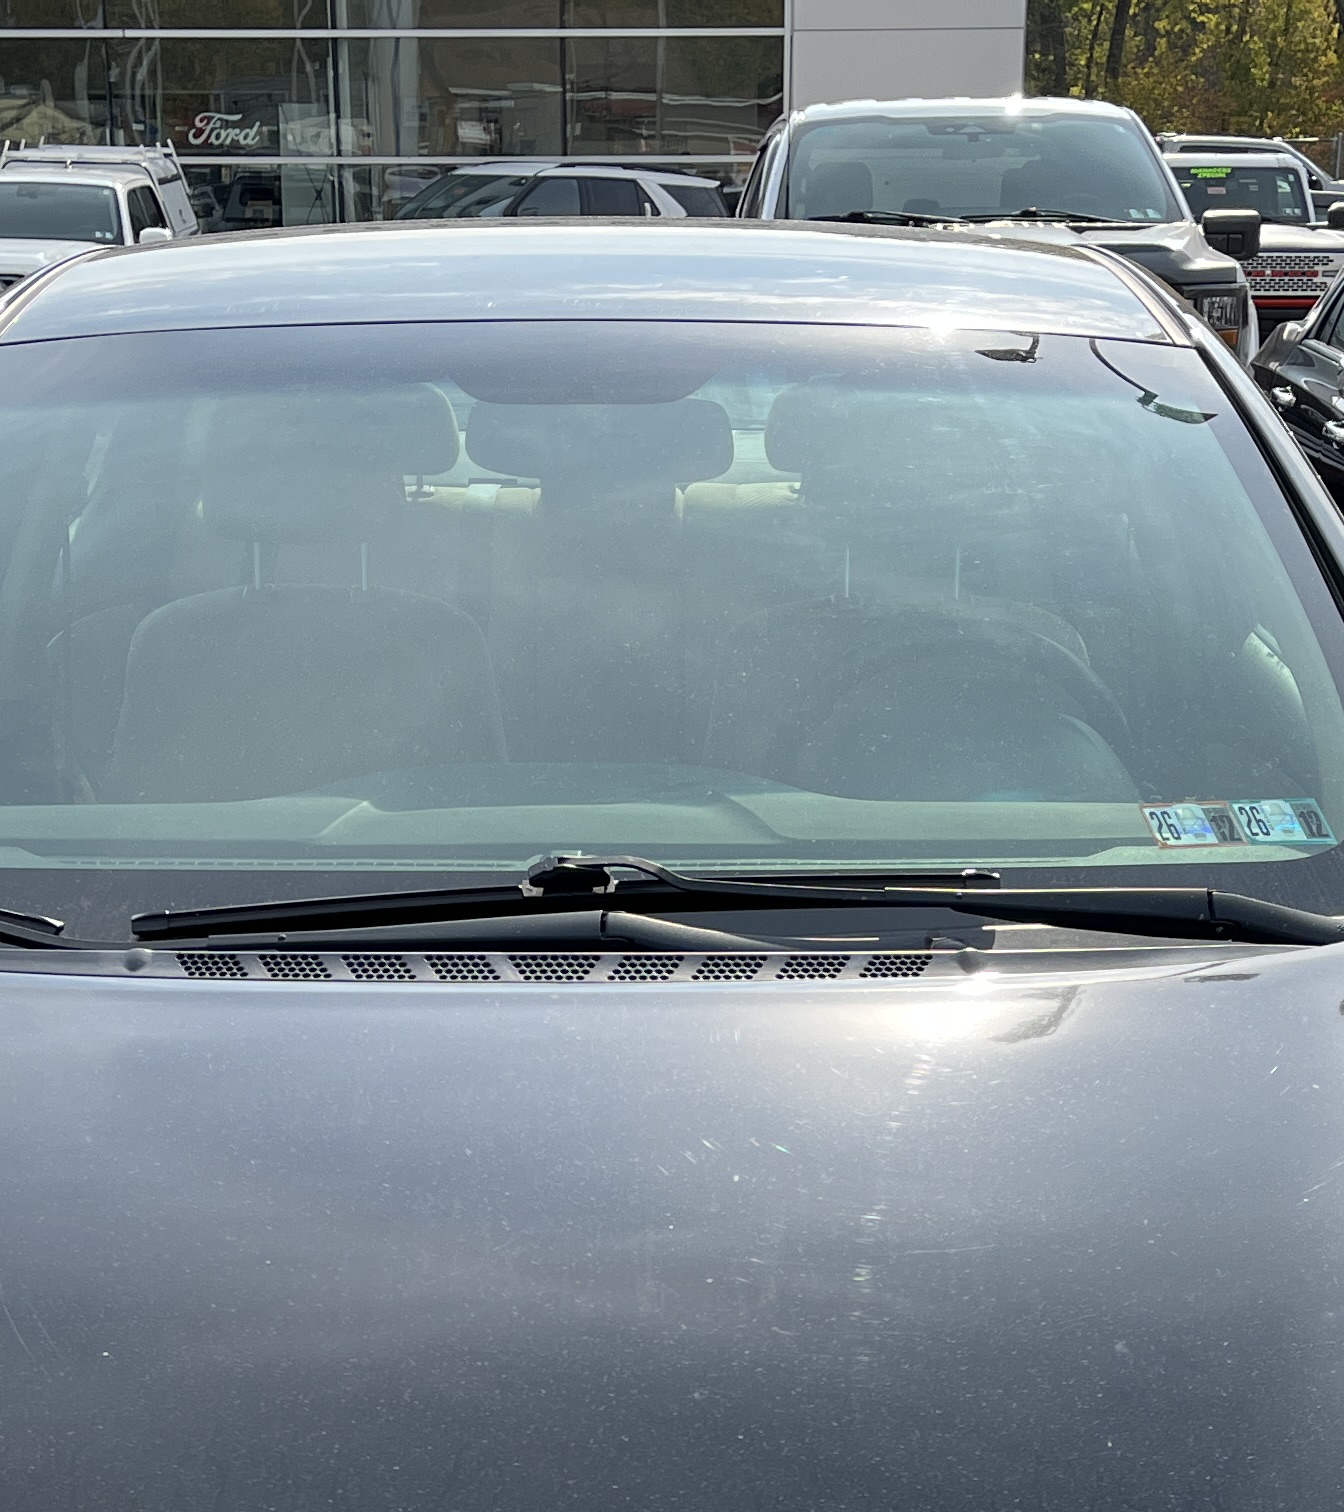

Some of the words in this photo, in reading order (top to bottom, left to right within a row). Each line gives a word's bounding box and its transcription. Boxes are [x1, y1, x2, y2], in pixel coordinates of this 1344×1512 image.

[187, 112, 261, 146] Ford
[1149, 811, 1182, 841] 26
[1209, 814, 1243, 842] 12
[1238, 805, 1271, 837] 26
[1298, 810, 1330, 838] 12
